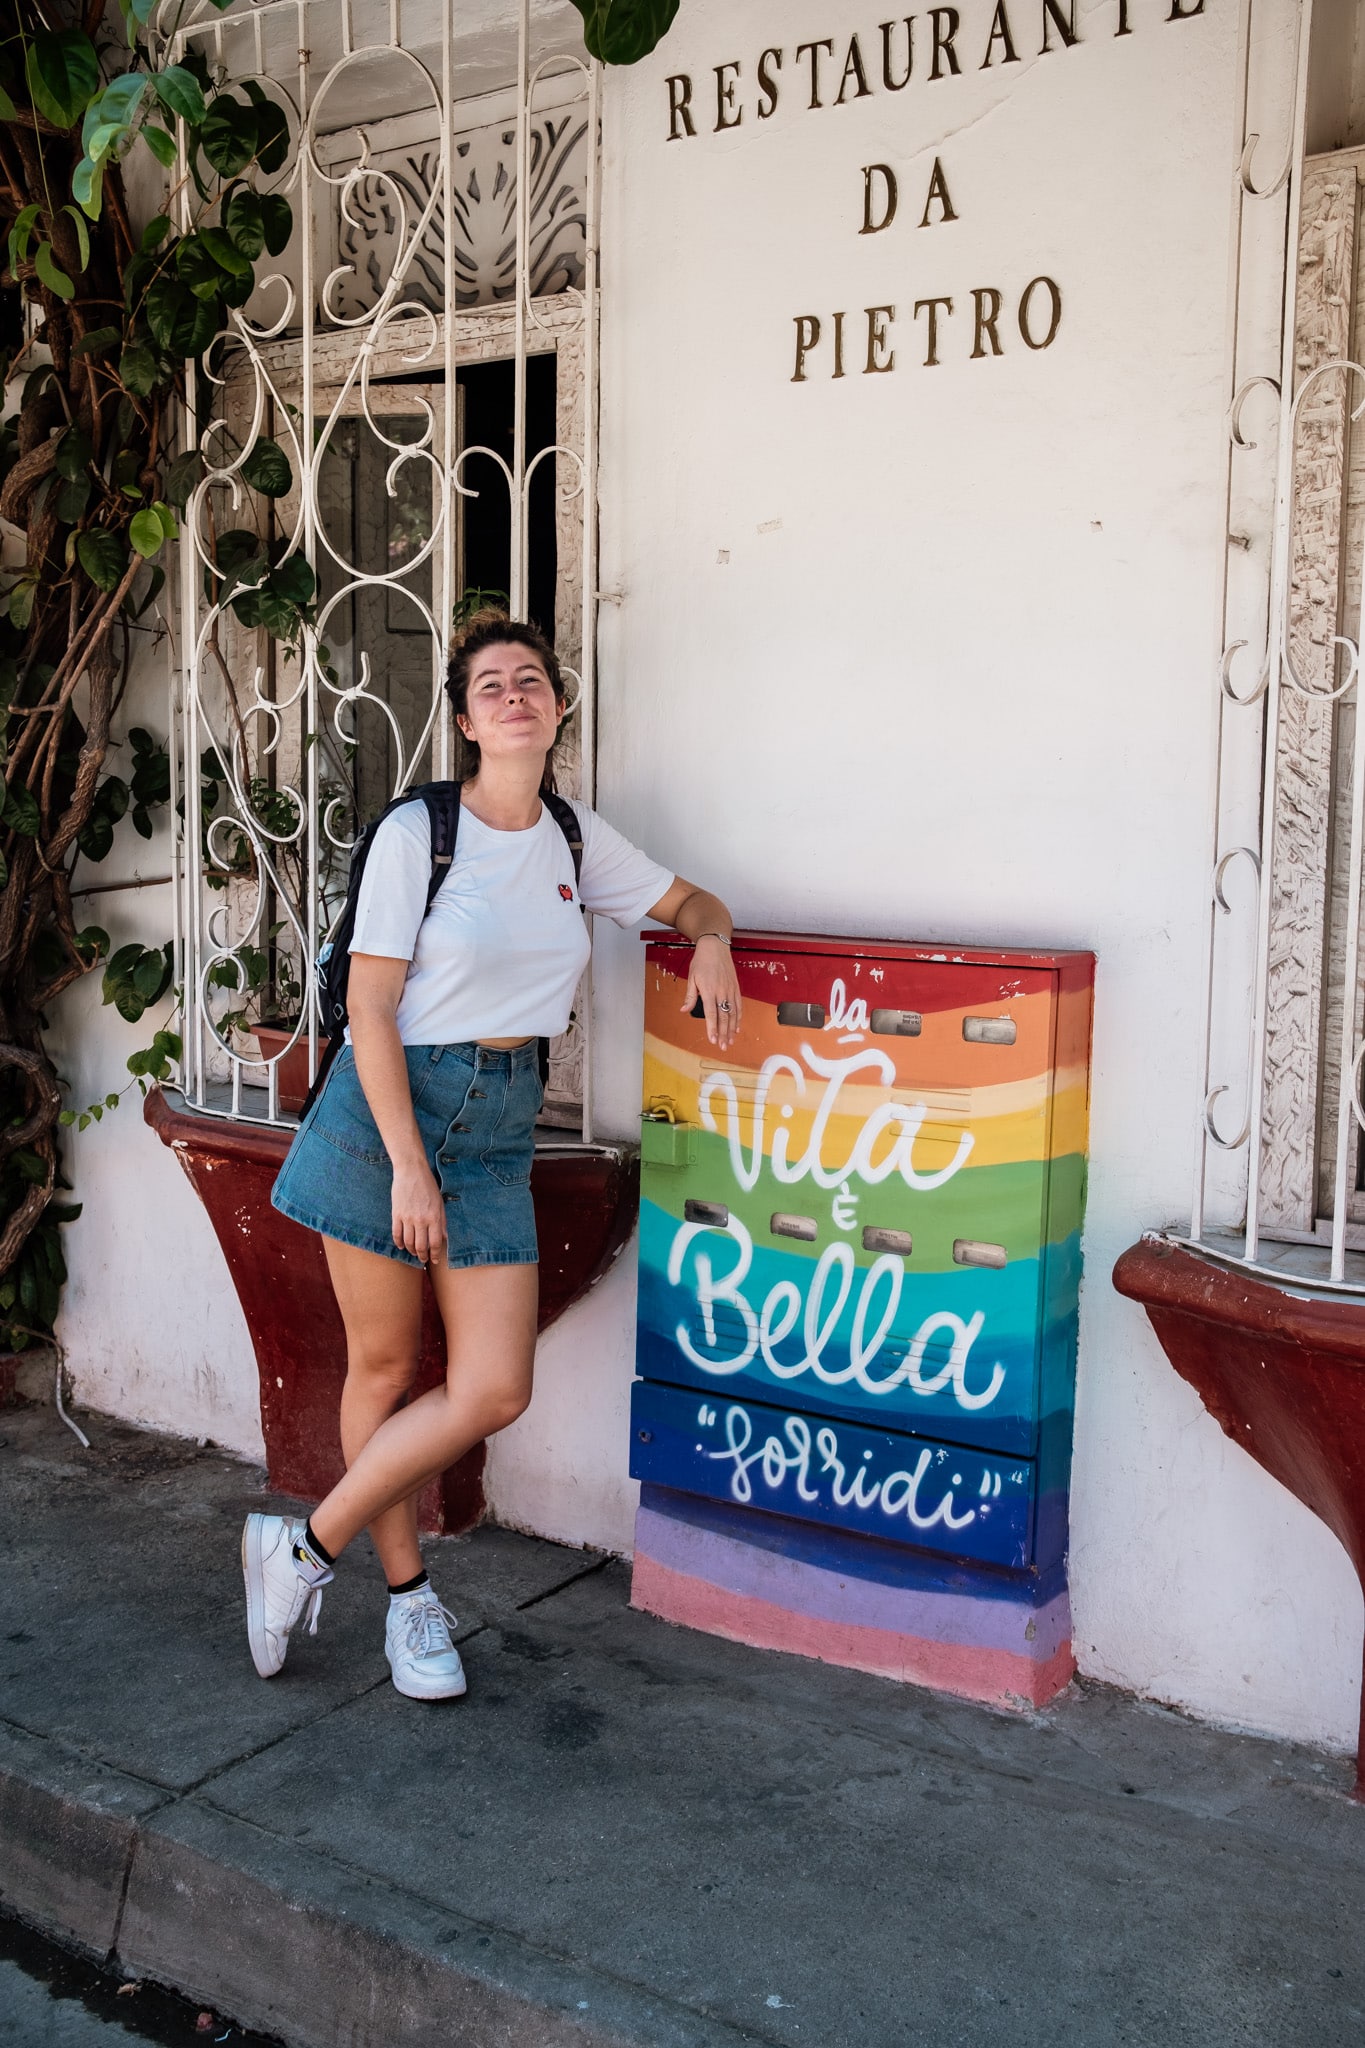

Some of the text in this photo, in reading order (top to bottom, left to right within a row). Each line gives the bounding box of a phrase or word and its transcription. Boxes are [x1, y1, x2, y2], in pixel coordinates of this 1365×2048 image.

[664, 0, 1204, 141] RESTAURAN
[858, 157, 959, 235] DA
[790, 276, 1062, 382] PIETRO
[668, 1212, 1006, 1410] Bella
